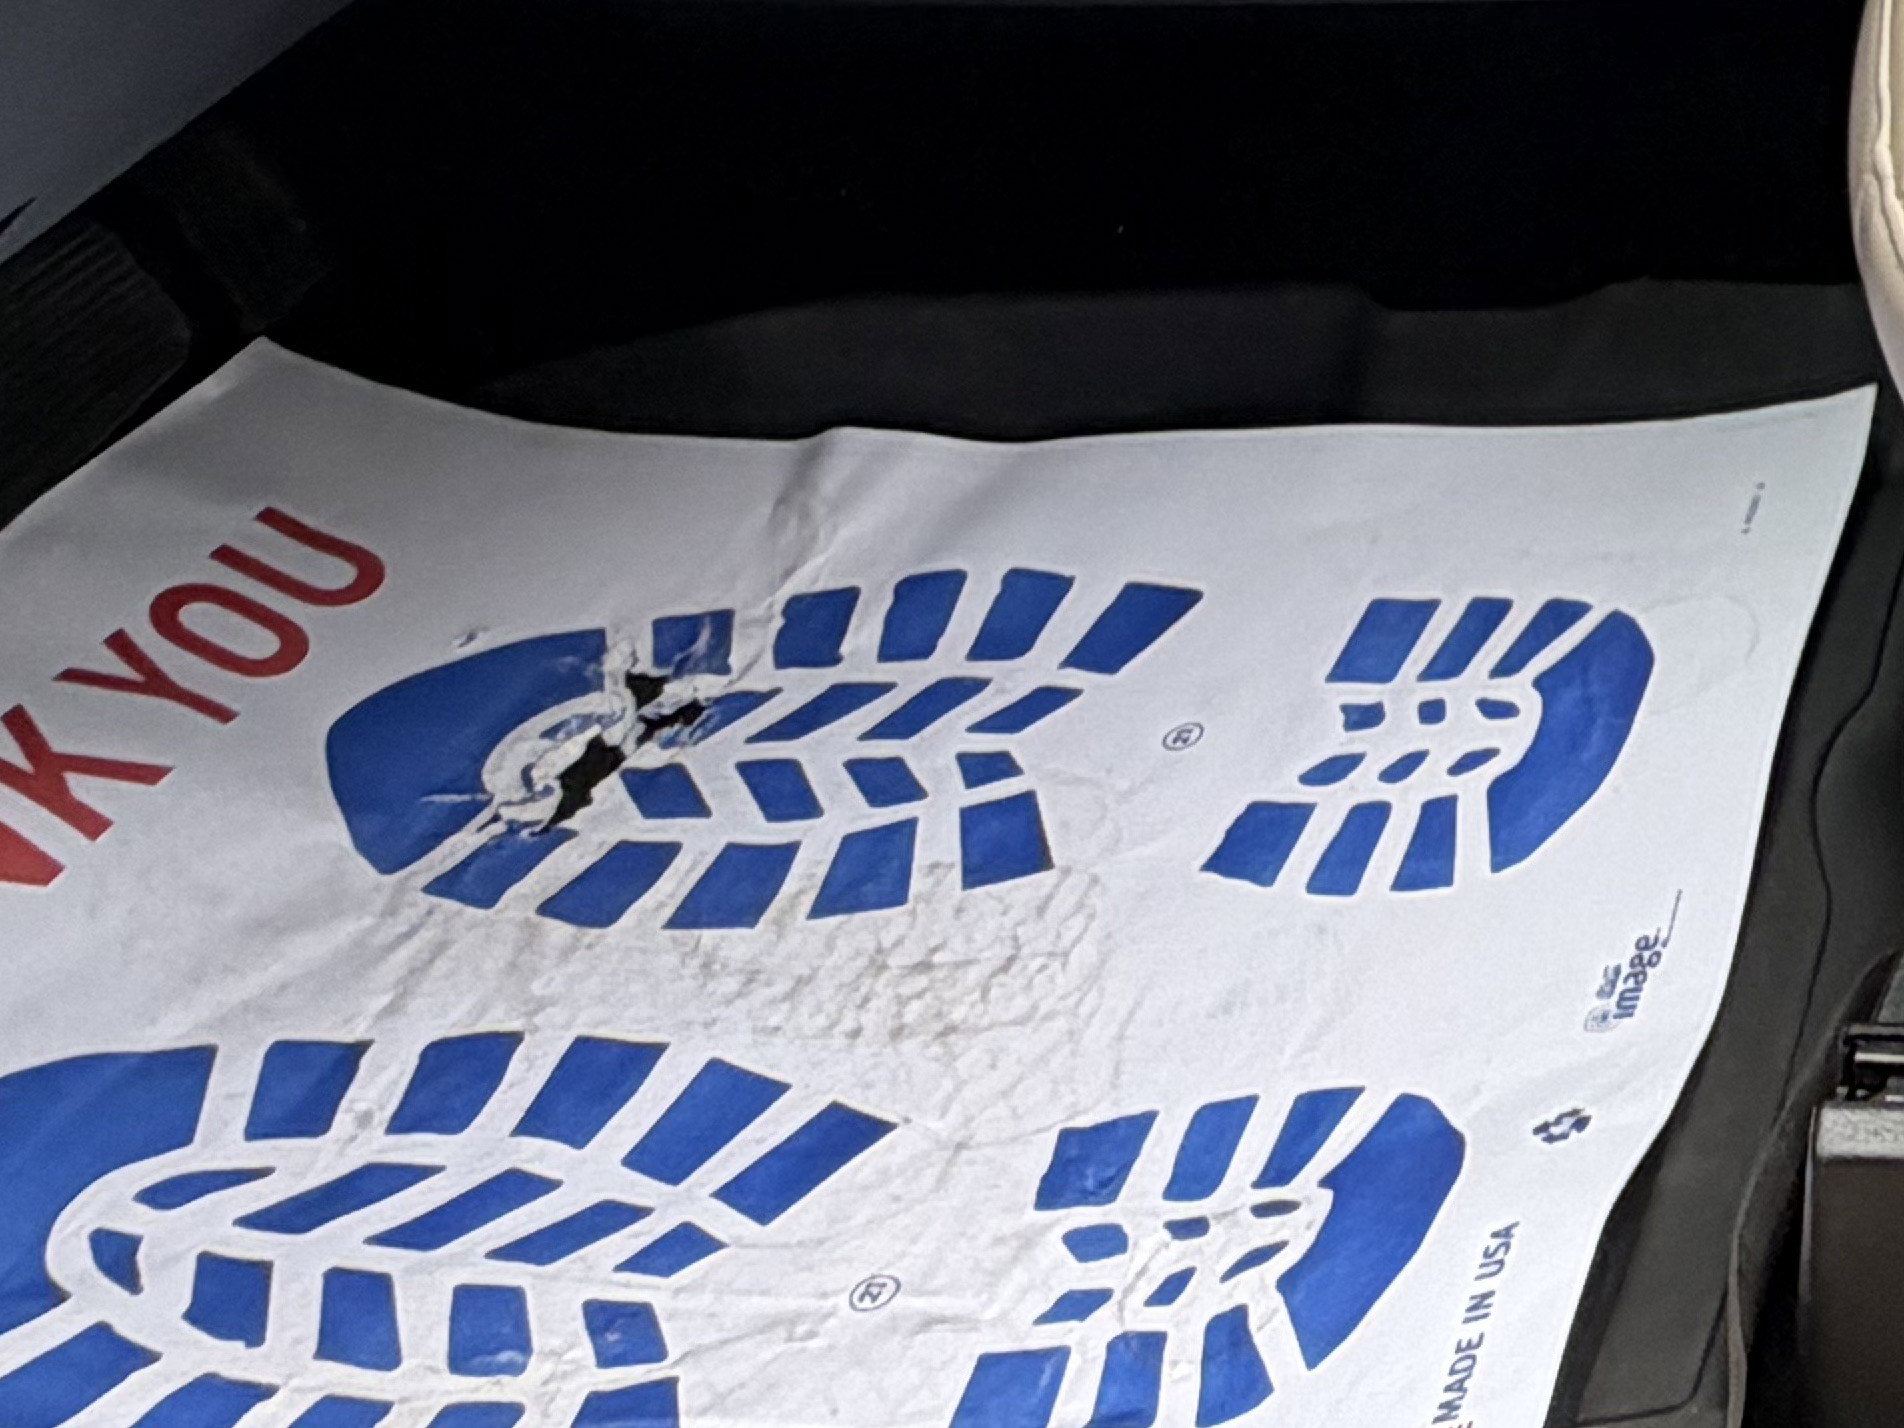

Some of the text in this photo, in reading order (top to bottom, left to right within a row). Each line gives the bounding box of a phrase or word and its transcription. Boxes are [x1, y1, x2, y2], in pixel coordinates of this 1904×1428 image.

[52, 506, 386, 726] YOU
[1475, 1221, 1520, 1283] USA
[1462, 1288, 1497, 1325] IN
[1431, 1331, 1485, 1425] MADE
